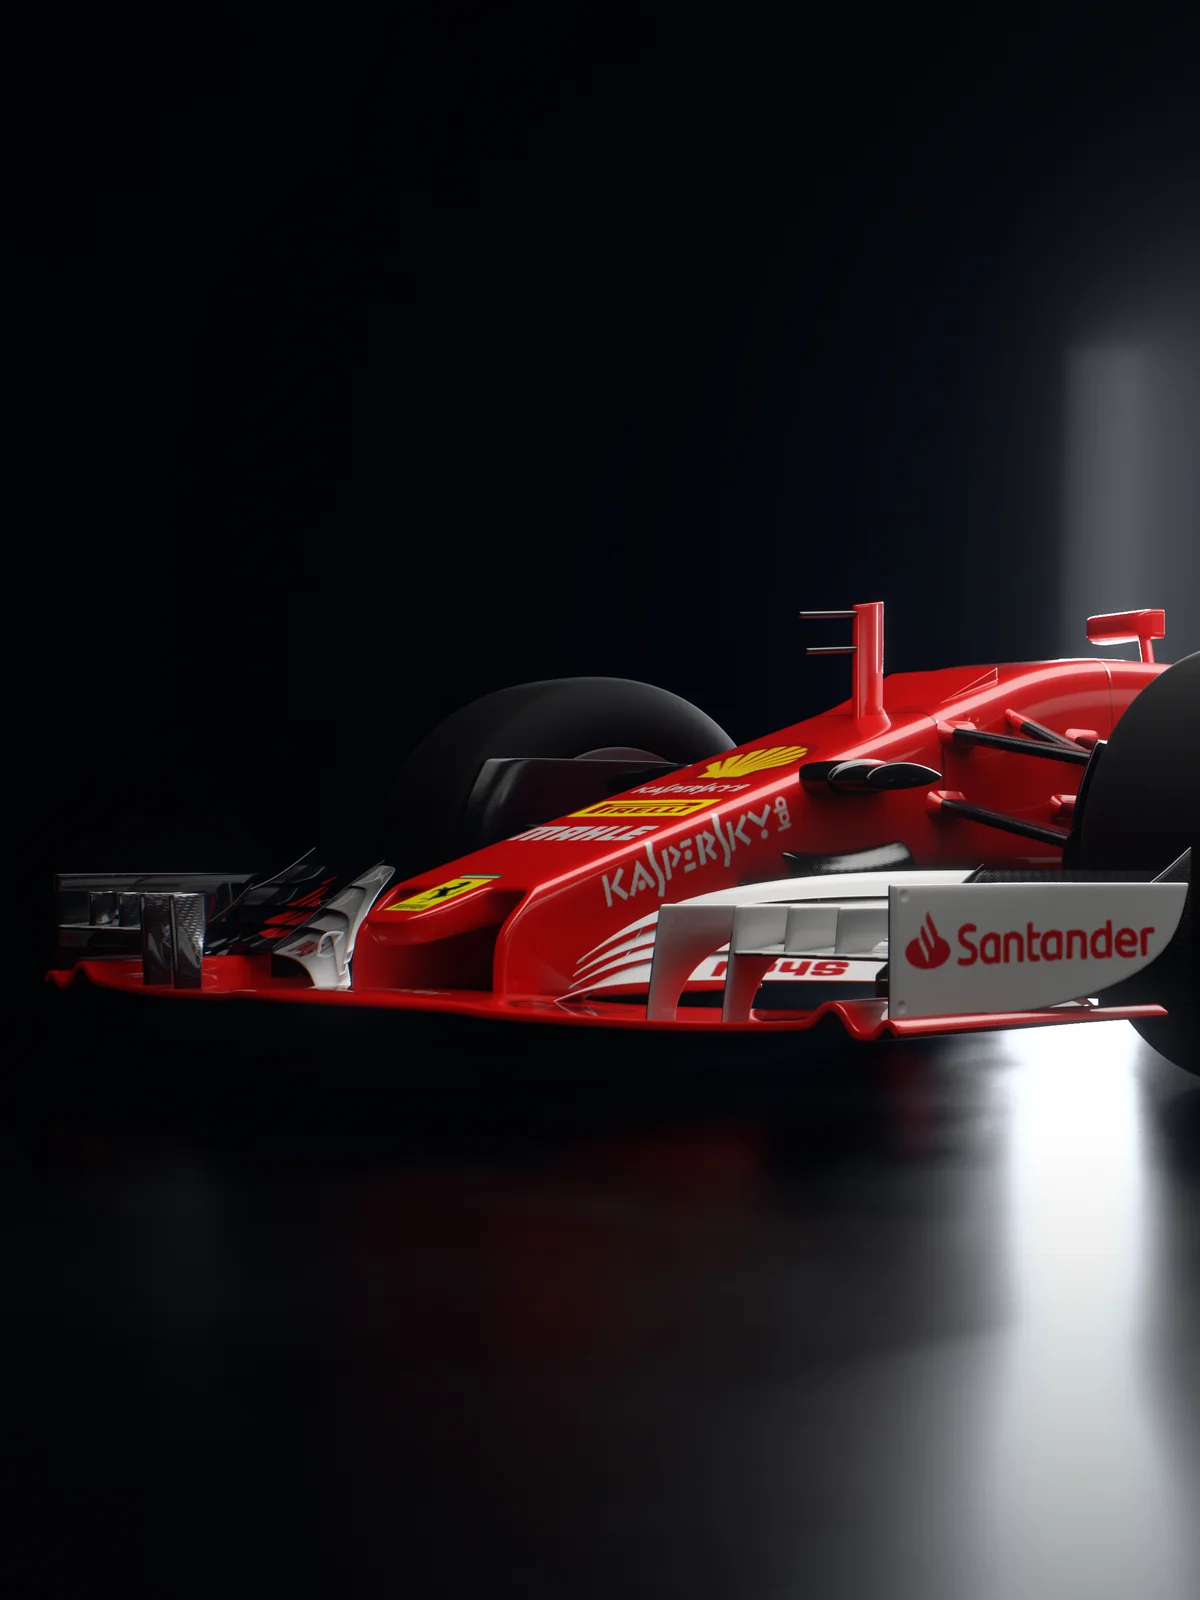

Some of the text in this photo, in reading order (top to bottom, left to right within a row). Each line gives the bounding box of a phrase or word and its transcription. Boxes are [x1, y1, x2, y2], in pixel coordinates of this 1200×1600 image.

[584, 802, 703, 814] PIRELLI
[506, 825, 660, 841] MAHLE
[602, 813, 771, 908] KASPERSKY
[957, 919, 1155, 967] Santander
